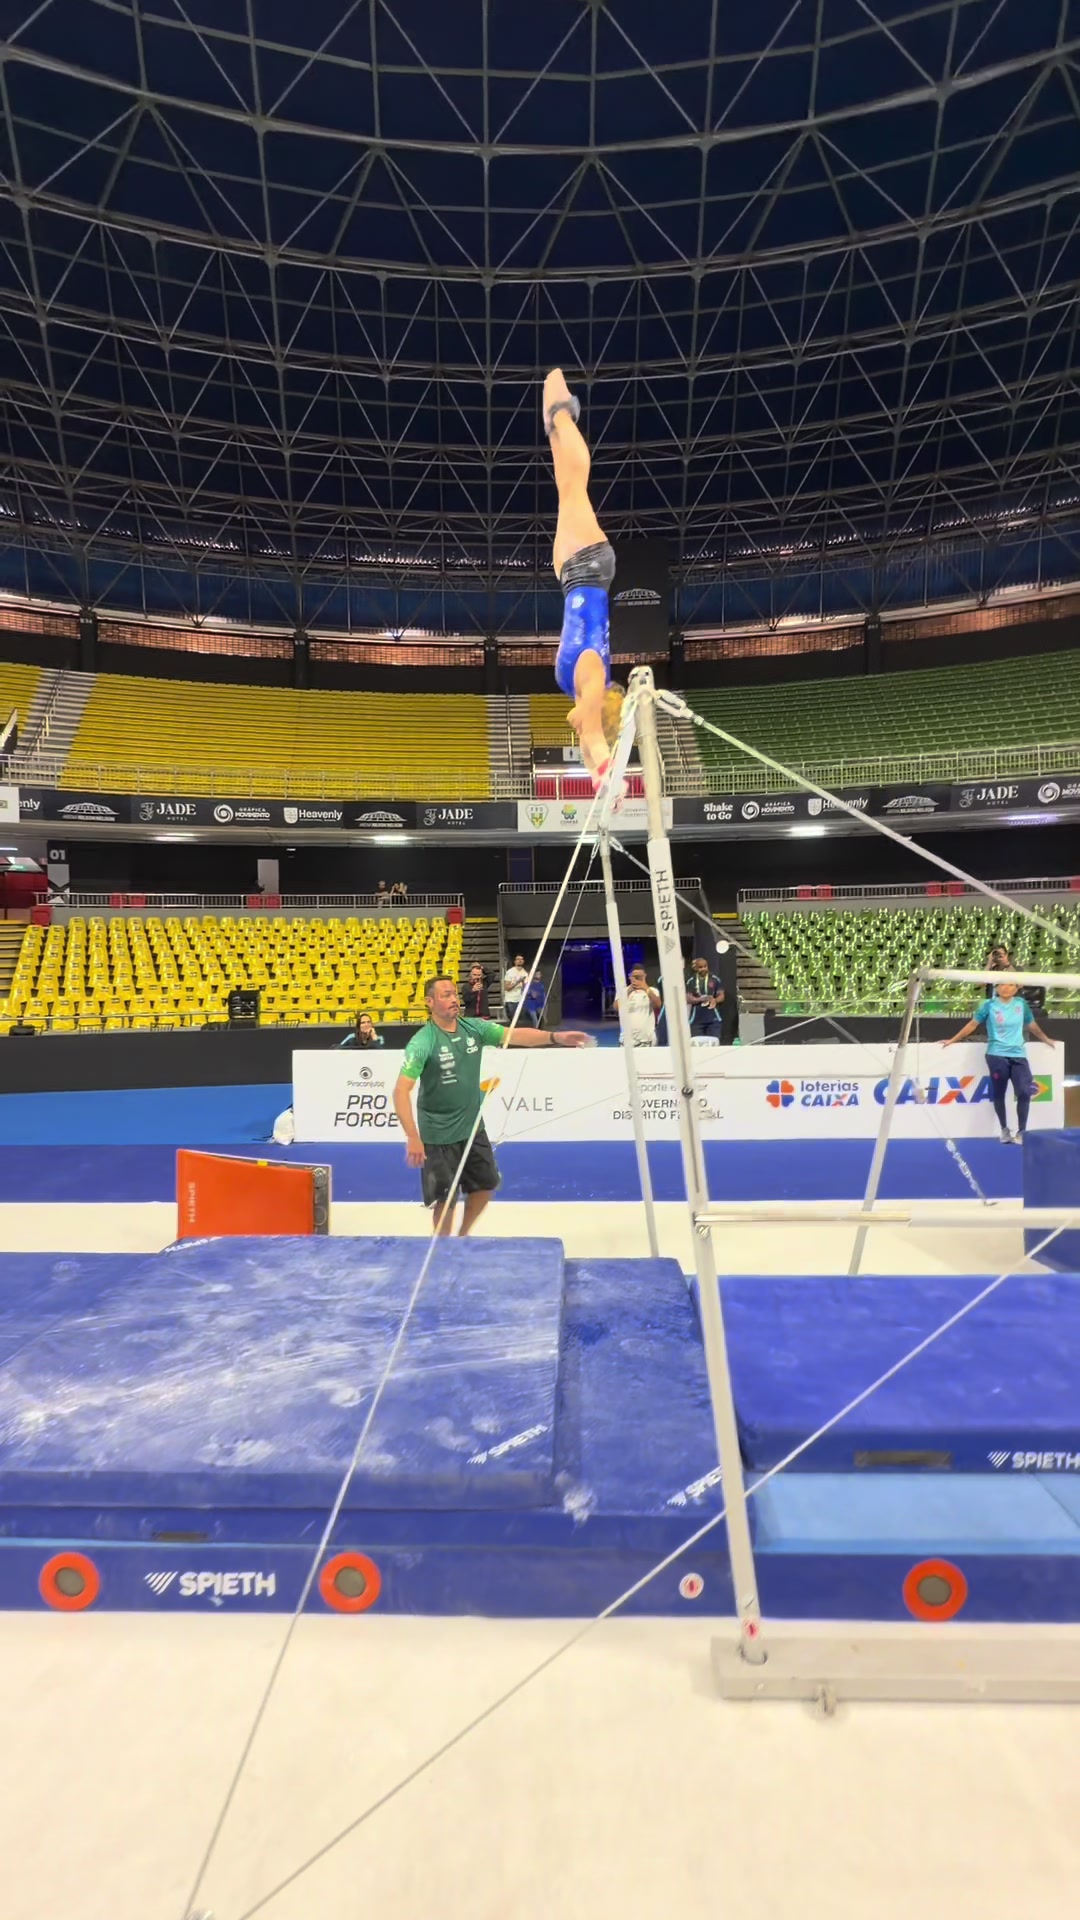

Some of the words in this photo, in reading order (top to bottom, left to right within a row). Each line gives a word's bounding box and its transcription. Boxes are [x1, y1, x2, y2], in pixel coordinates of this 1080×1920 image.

[977, 785, 1019, 800] JADE
[156, 803, 197, 815] JADE
[438, 808, 474, 820] JADE
[703, 802, 734, 812] Shake
[299, 809, 343, 820] Heavenly
[706, 812, 717, 820] to
[718, 812, 732, 820] Go
[50, 849, 66, 860] 01
[656, 869, 675, 932] SPIETH
[800, 1080, 859, 1092] loterias
[873, 1075, 995, 1105] CAIXA
[347, 1094, 387, 1109] PRO
[501, 1096, 554, 1111] VALE
[800, 1093, 859, 1107] CAIXA
[334, 1112, 400, 1127] FORCE
[1012, 1451, 1080, 1469] SPIETH
[179, 1571, 276, 1597] SPIETH
